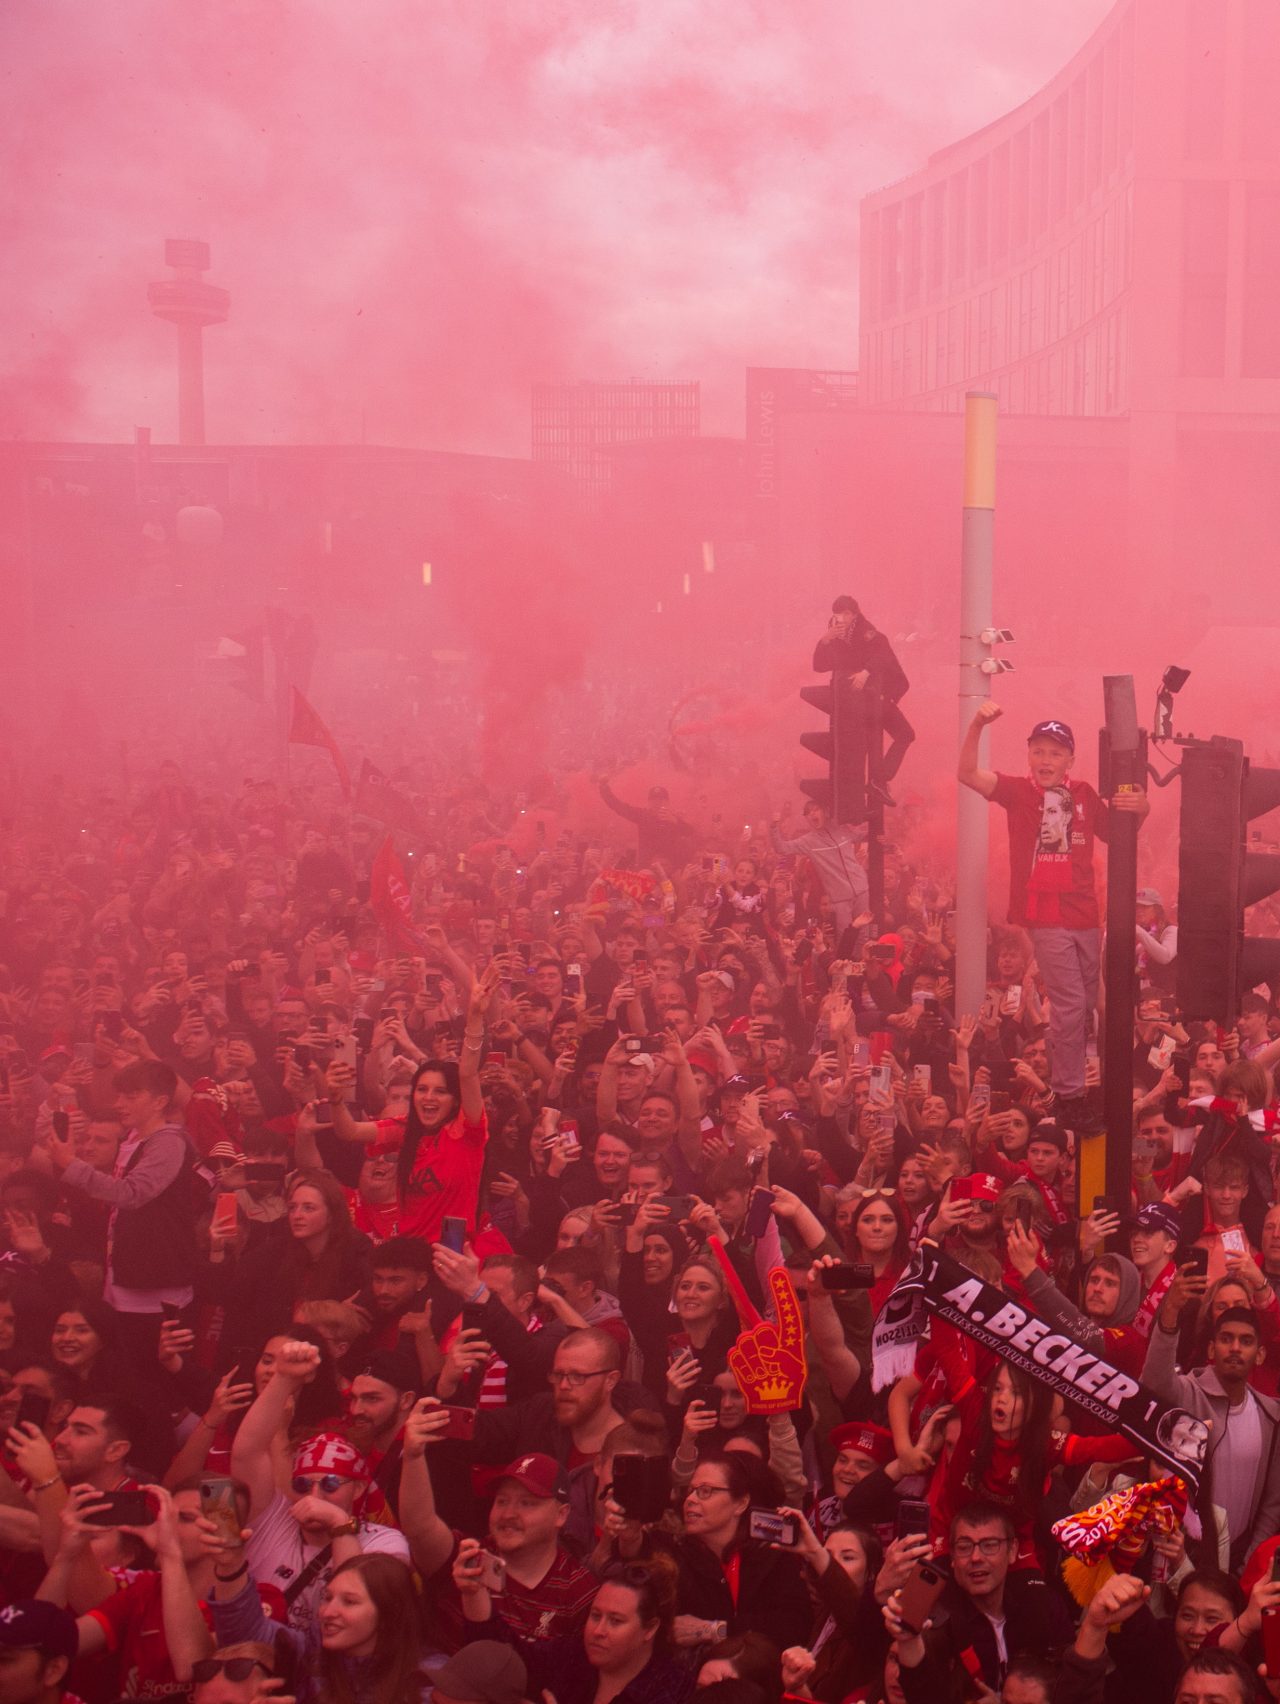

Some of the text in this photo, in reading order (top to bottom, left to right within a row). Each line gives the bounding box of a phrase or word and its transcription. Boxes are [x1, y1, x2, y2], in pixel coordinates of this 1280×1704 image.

[755, 391, 777, 500] John Lewis
[1037, 854, 1053, 863] VAN
[928, 1260, 939, 1282] 1
[1144, 1400, 1158, 1422] 1
